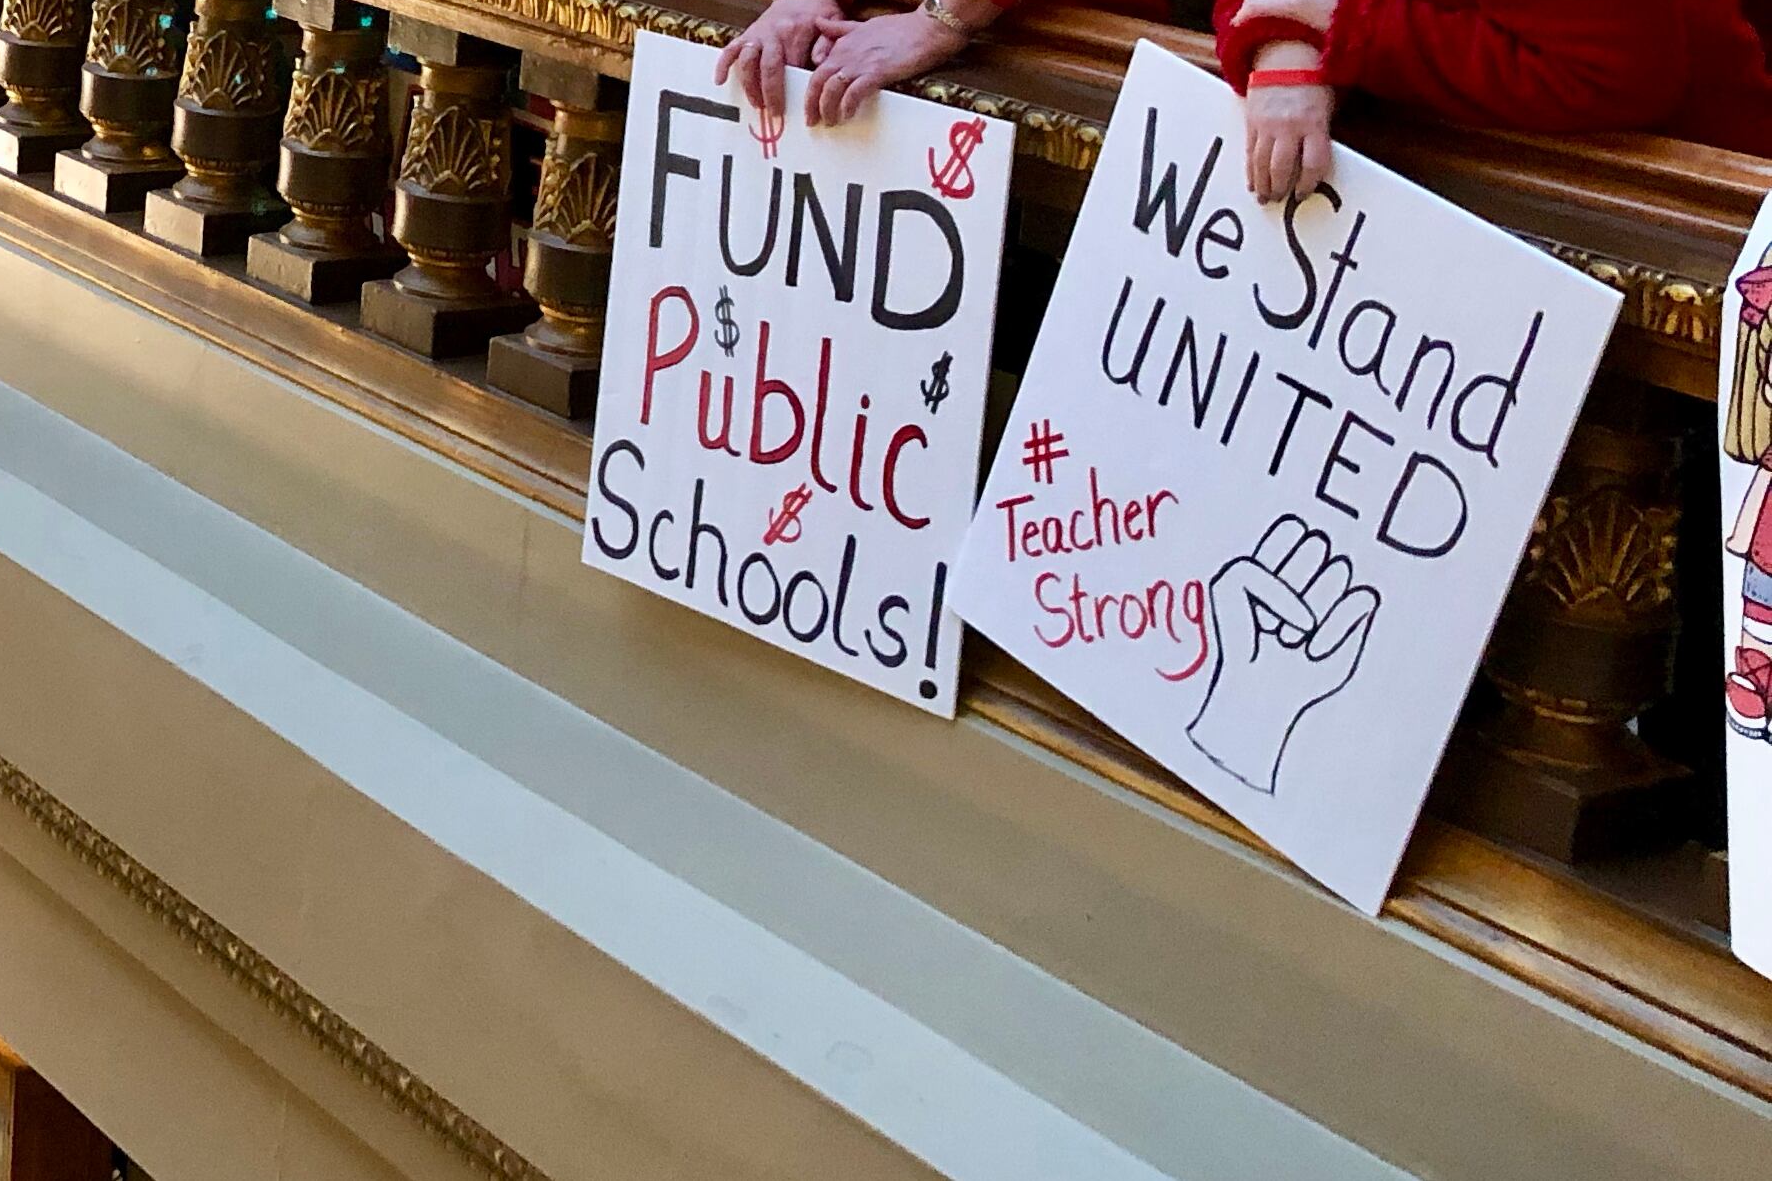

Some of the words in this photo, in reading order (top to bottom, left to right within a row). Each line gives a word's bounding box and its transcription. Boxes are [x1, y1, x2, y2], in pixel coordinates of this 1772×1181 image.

[649, 89, 964, 331] FUND
[1132, 106, 1244, 279] We
[1253, 180, 1545, 469] Stand
[639, 285, 931, 530] Public
[996, 466, 1180, 563] Teacher
[1101, 276, 1469, 559] UNITED
[591, 438, 948, 701] Schools!
[1033, 571, 1209, 682] Strong
